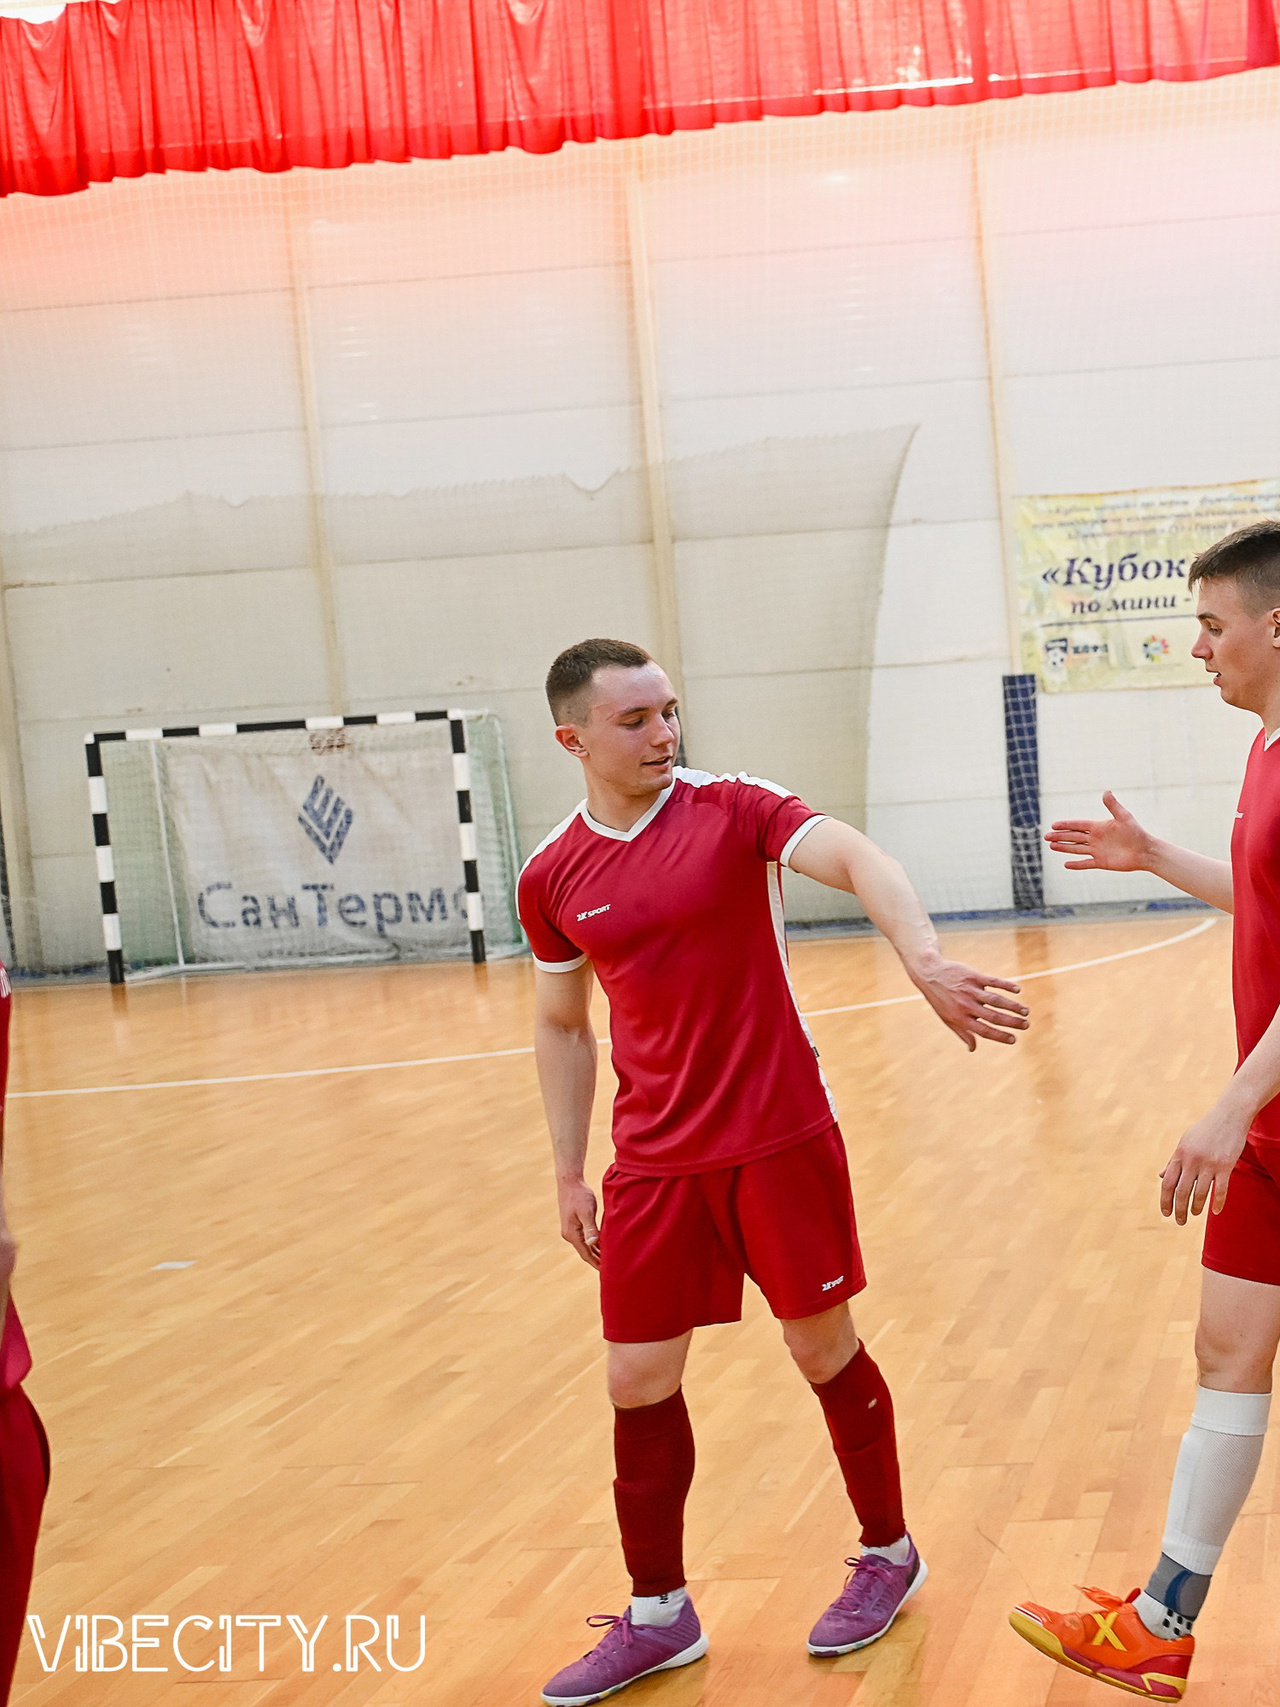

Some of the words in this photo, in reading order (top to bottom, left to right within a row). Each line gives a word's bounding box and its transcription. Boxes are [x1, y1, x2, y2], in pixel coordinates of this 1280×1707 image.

[1042, 552, 1186, 591] «Кубок
[1070, 600, 1101, 614] по
[1106, 595, 1176, 612] мини
